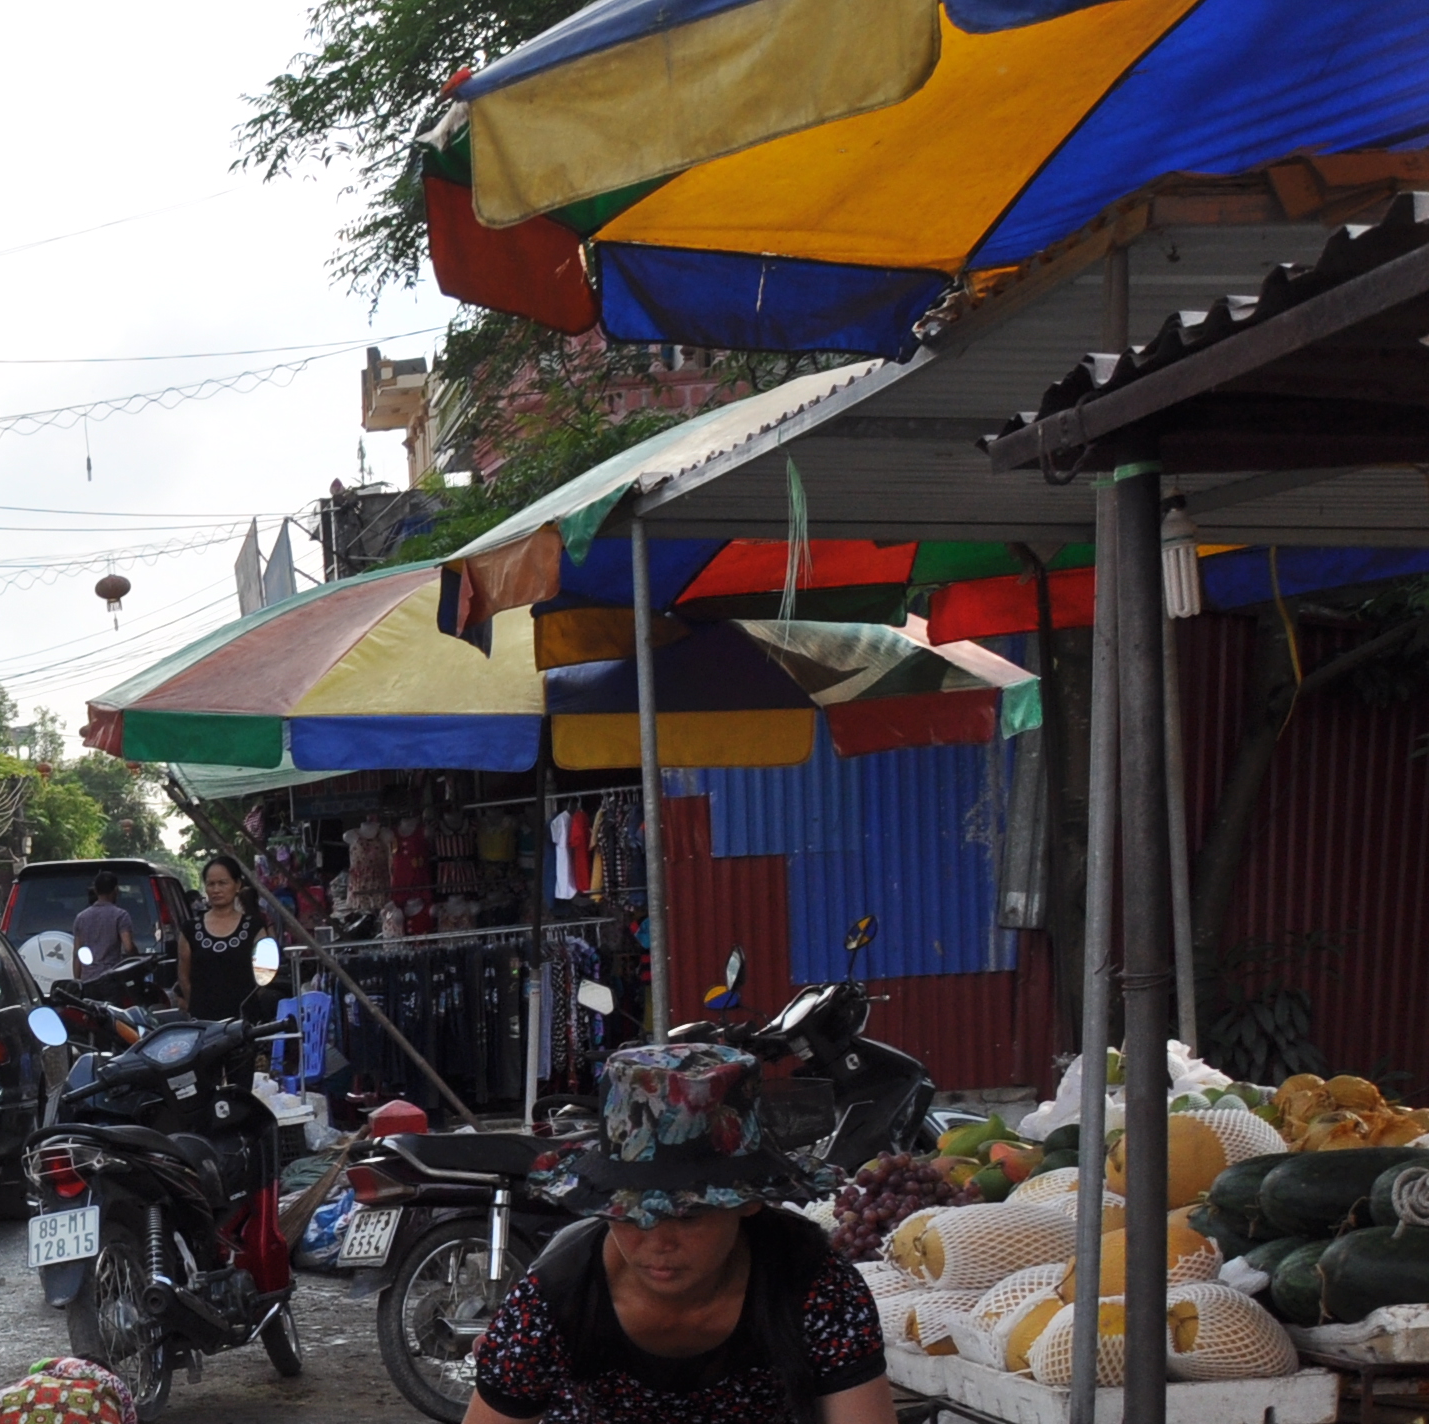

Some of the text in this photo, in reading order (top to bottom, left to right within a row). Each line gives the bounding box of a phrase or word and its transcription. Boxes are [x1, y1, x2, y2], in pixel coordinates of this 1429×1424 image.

[39, 1212, 87, 1239] 89-M1
[354, 1211, 392, 1234] 89-F3
[34, 1232, 94, 1263] 128.15
[346, 1234, 383, 1256] 6554
